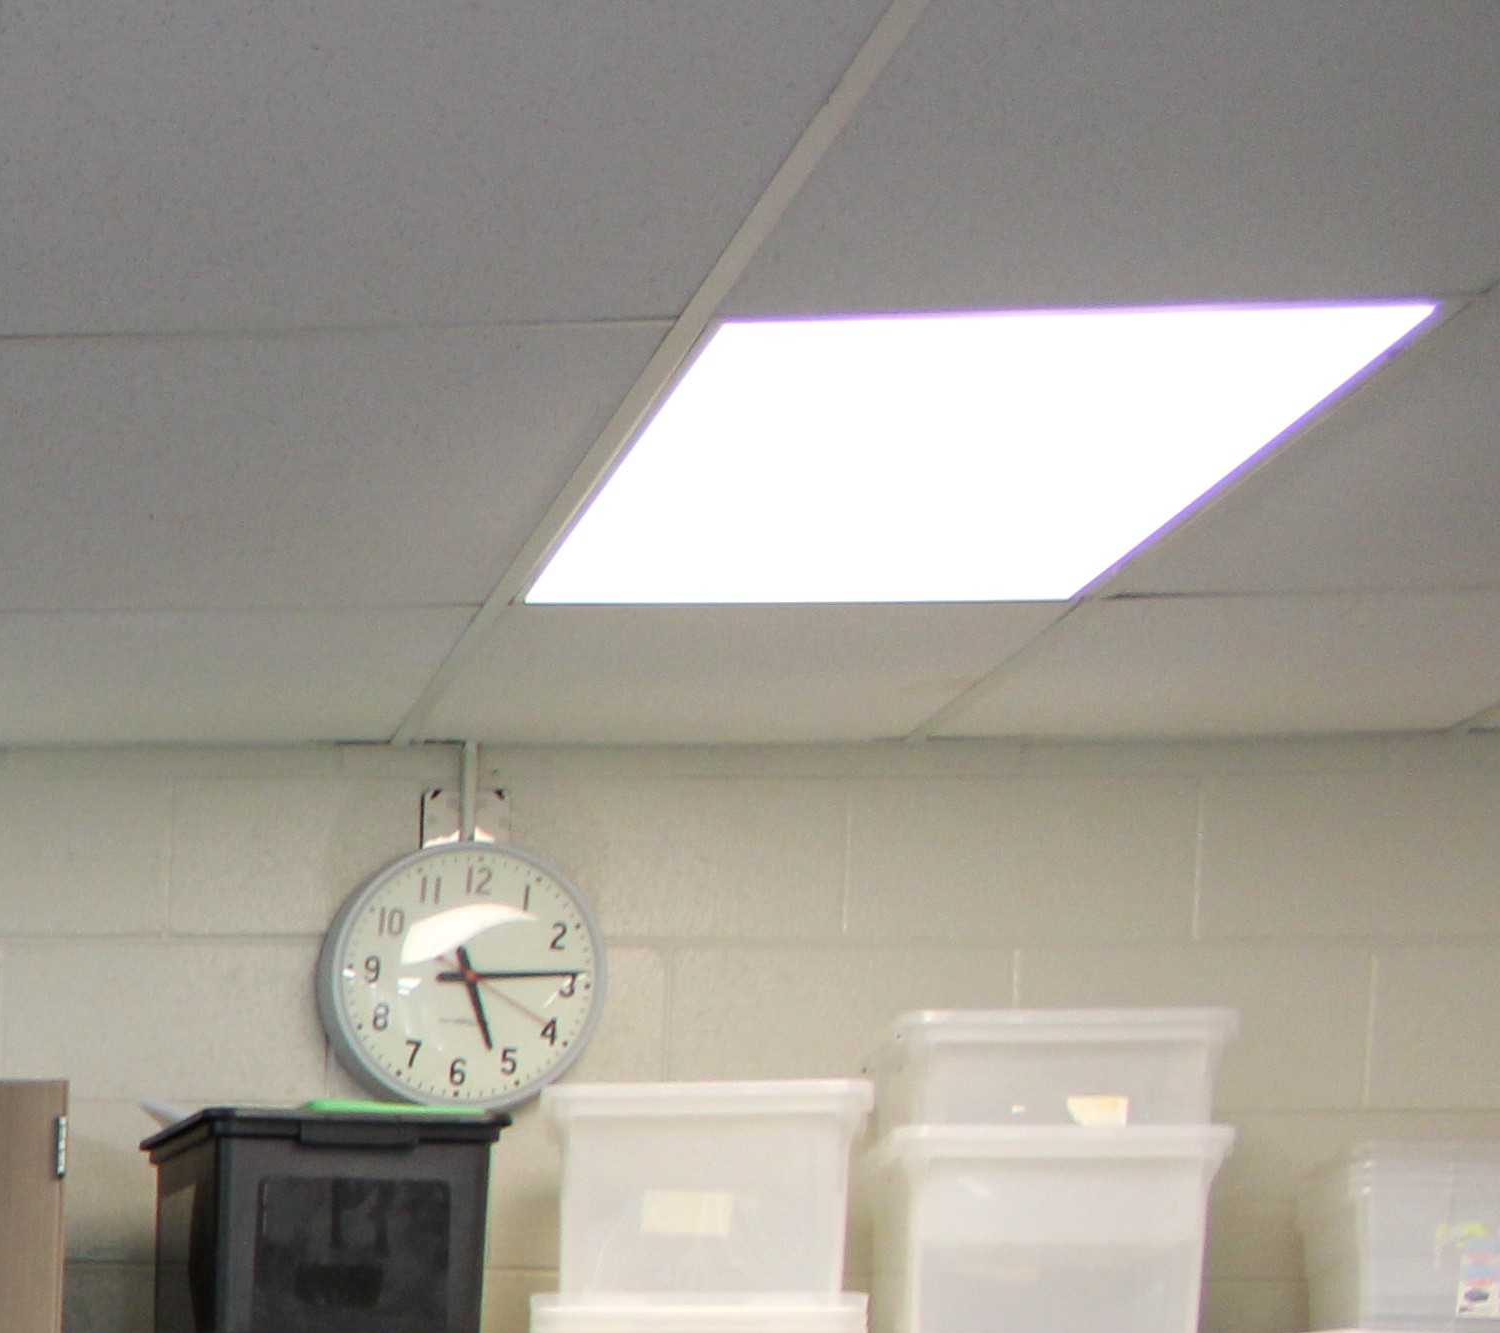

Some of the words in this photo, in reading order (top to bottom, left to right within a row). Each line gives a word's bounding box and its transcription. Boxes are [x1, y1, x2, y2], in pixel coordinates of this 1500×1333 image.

[419, 875, 443, 904] 11
[465, 867, 493, 895] 12
[522, 884, 530, 912] 1
[376, 908, 405, 936] 10
[549, 922, 568, 950] 2
[364, 956, 381, 983] 9
[558, 973, 577, 998] 3
[372, 1004, 389, 1031] 8
[540, 1018, 558, 1046] 4
[405, 1040, 422, 1067] 7
[501, 1048, 518, 1075] 5
[449, 1058, 467, 1085] 6
